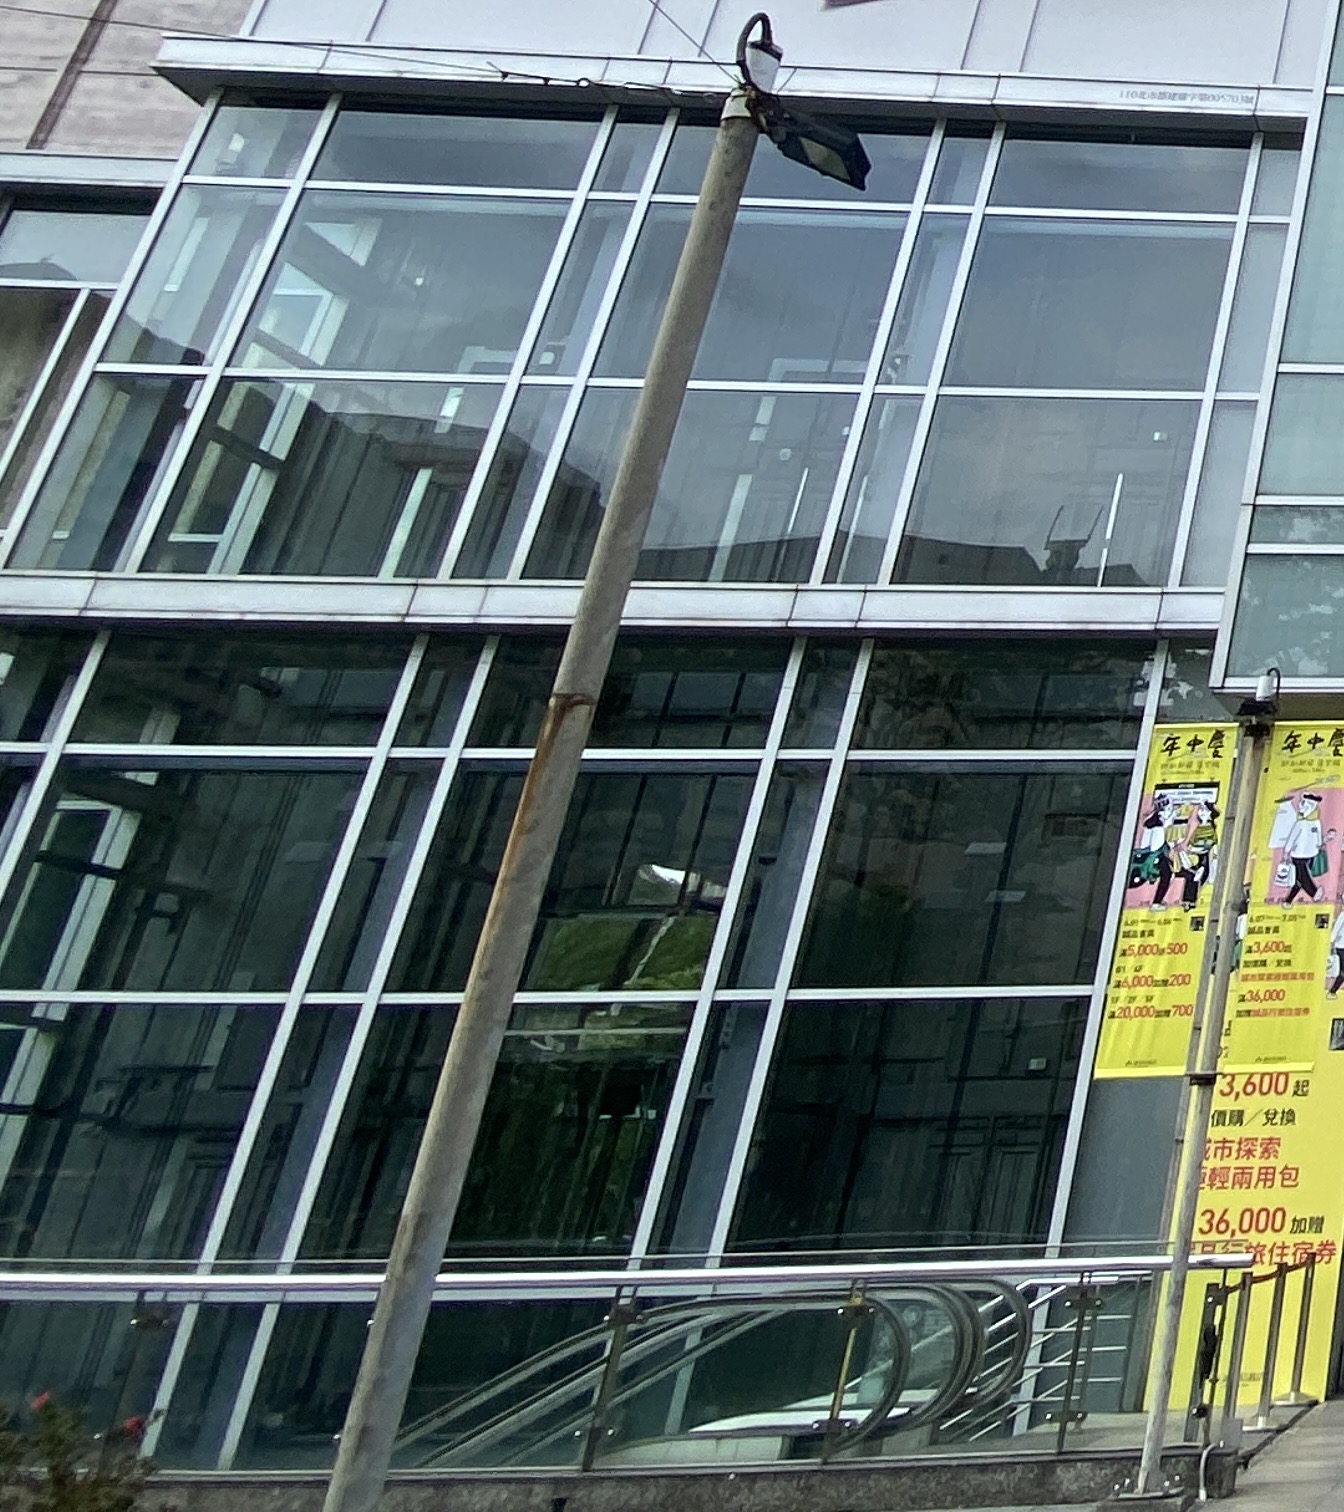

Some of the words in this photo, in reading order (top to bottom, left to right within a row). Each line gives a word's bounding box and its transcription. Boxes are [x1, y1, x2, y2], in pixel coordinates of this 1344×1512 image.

[1219, 1073, 1290, 1101] 3,600
[1292, 1079, 1310, 1097] 起
[1199, 1207, 1287, 1238] 36,000
